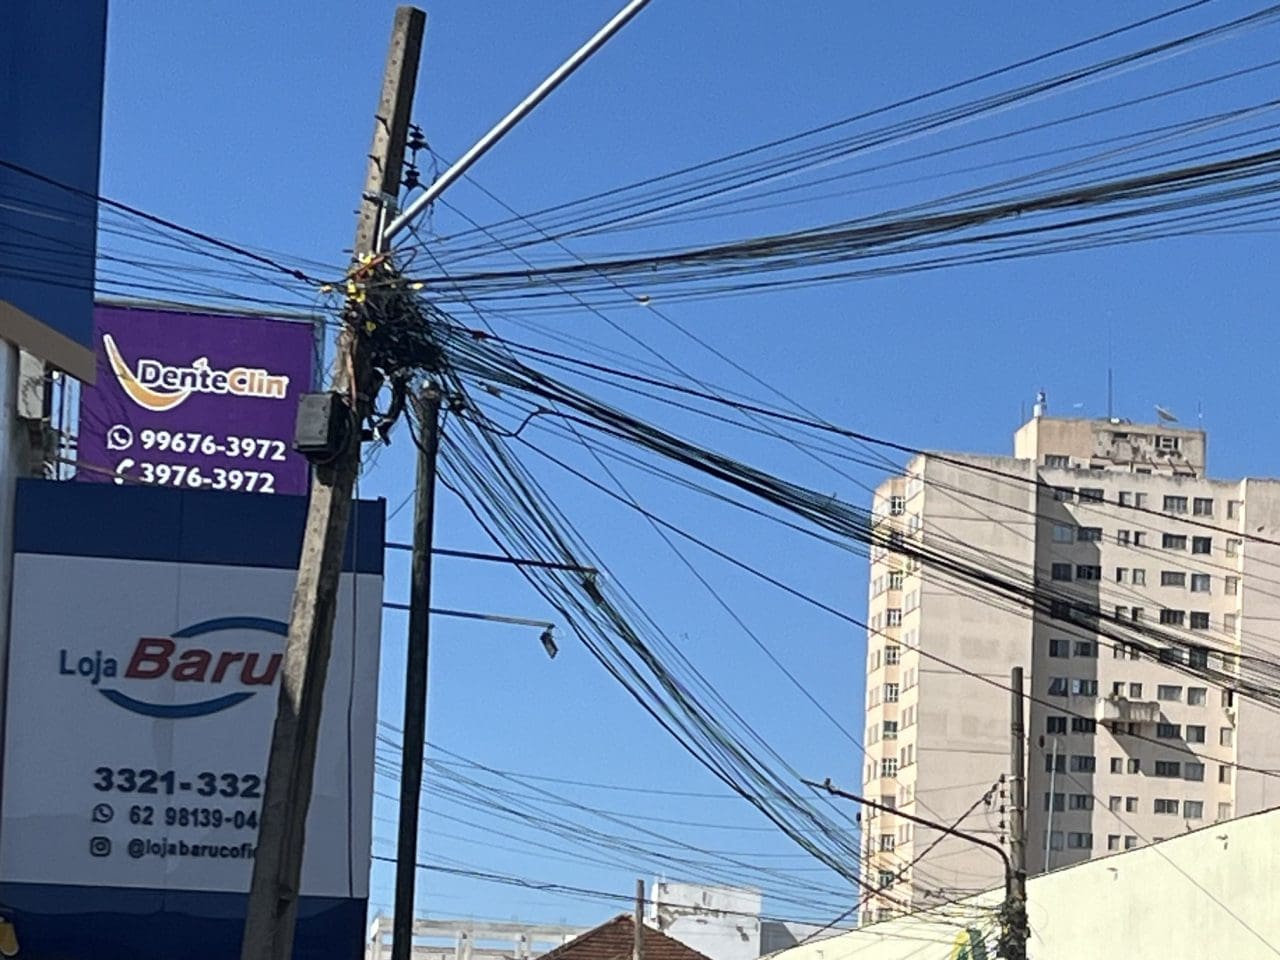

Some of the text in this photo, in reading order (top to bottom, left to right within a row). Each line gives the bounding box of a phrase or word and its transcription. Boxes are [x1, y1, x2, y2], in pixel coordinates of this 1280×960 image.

[138, 357, 289, 398] DenteClin
[140, 430, 286, 461] 99676-3972
[140, 463, 275, 494] 3976-3972
[59, 637, 284, 686] Loja Baru
[94, 767, 261, 799] 3321-332
[129, 805, 258, 830] 62 98139-04
[128, 837, 256, 859] @lojabarucofi
